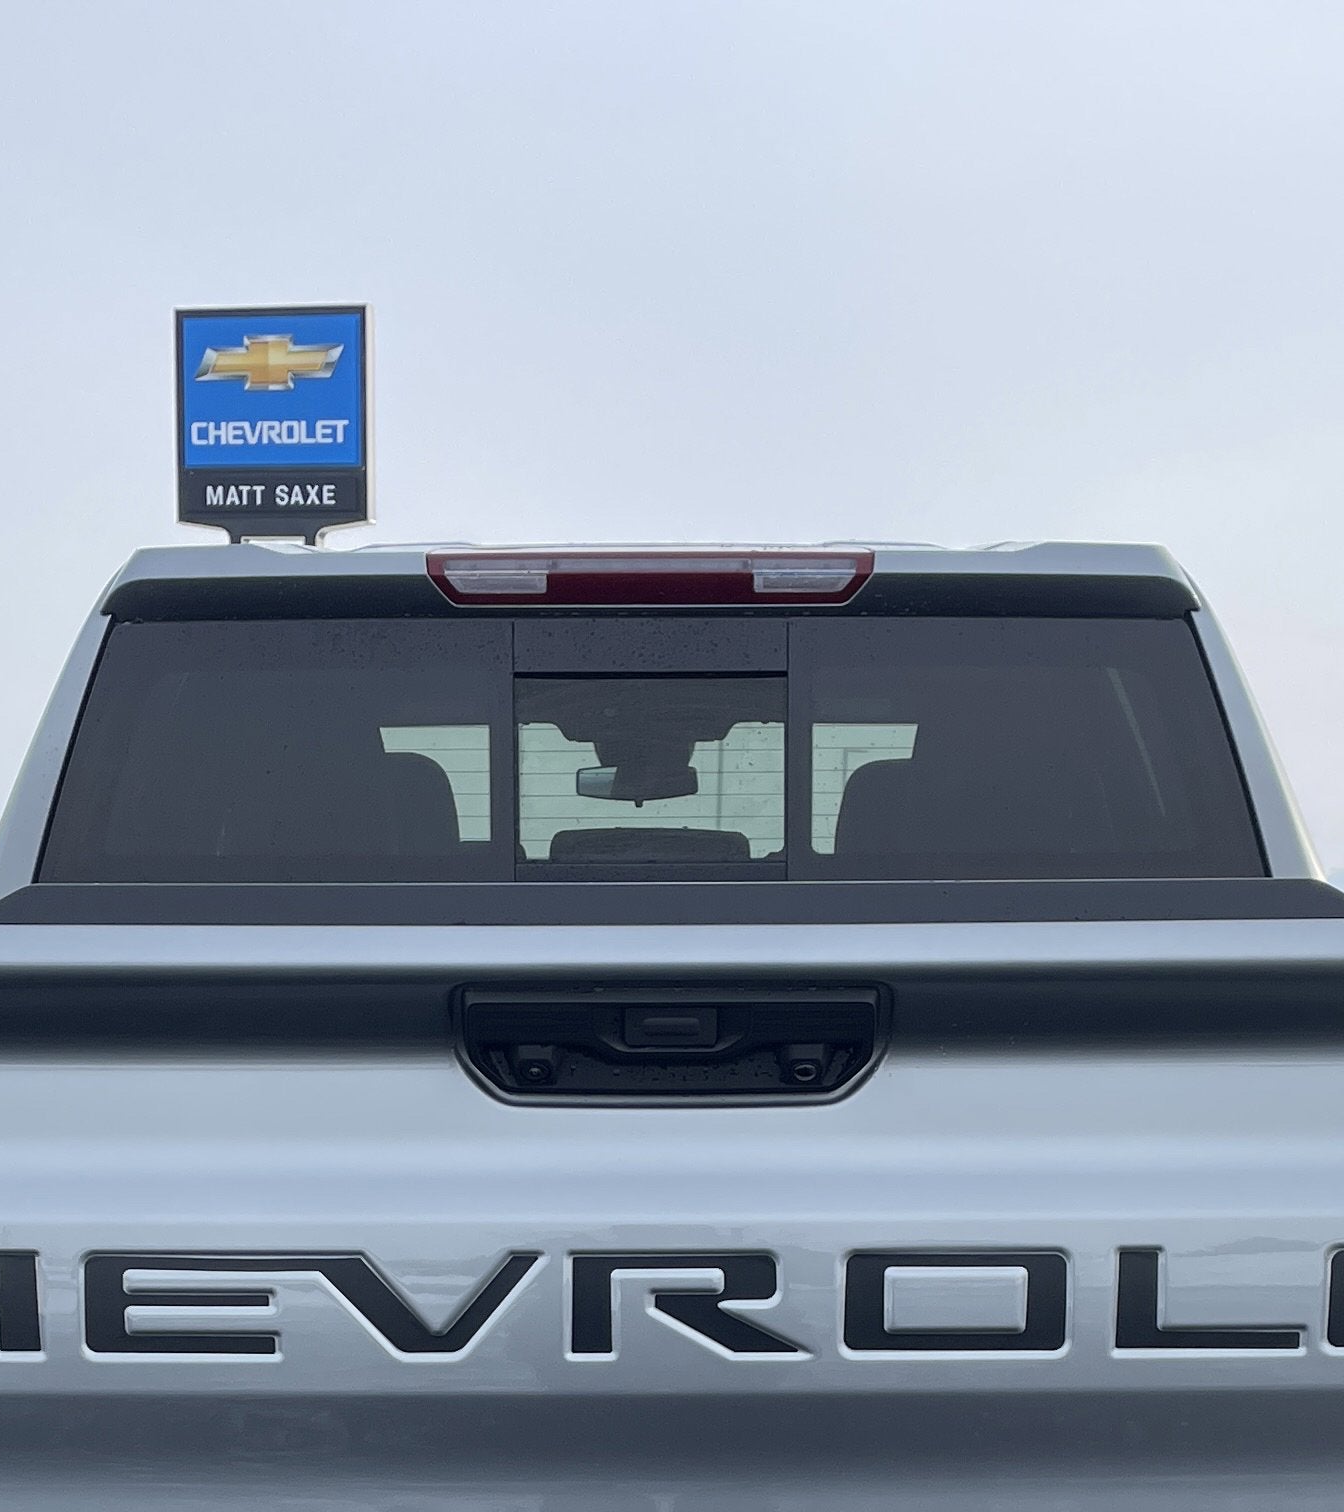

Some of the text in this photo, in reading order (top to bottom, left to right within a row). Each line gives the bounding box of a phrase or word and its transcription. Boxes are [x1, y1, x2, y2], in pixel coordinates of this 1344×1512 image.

[190, 419, 349, 445] CHEVROLET
[206, 484, 336, 505] MATT SAXE
